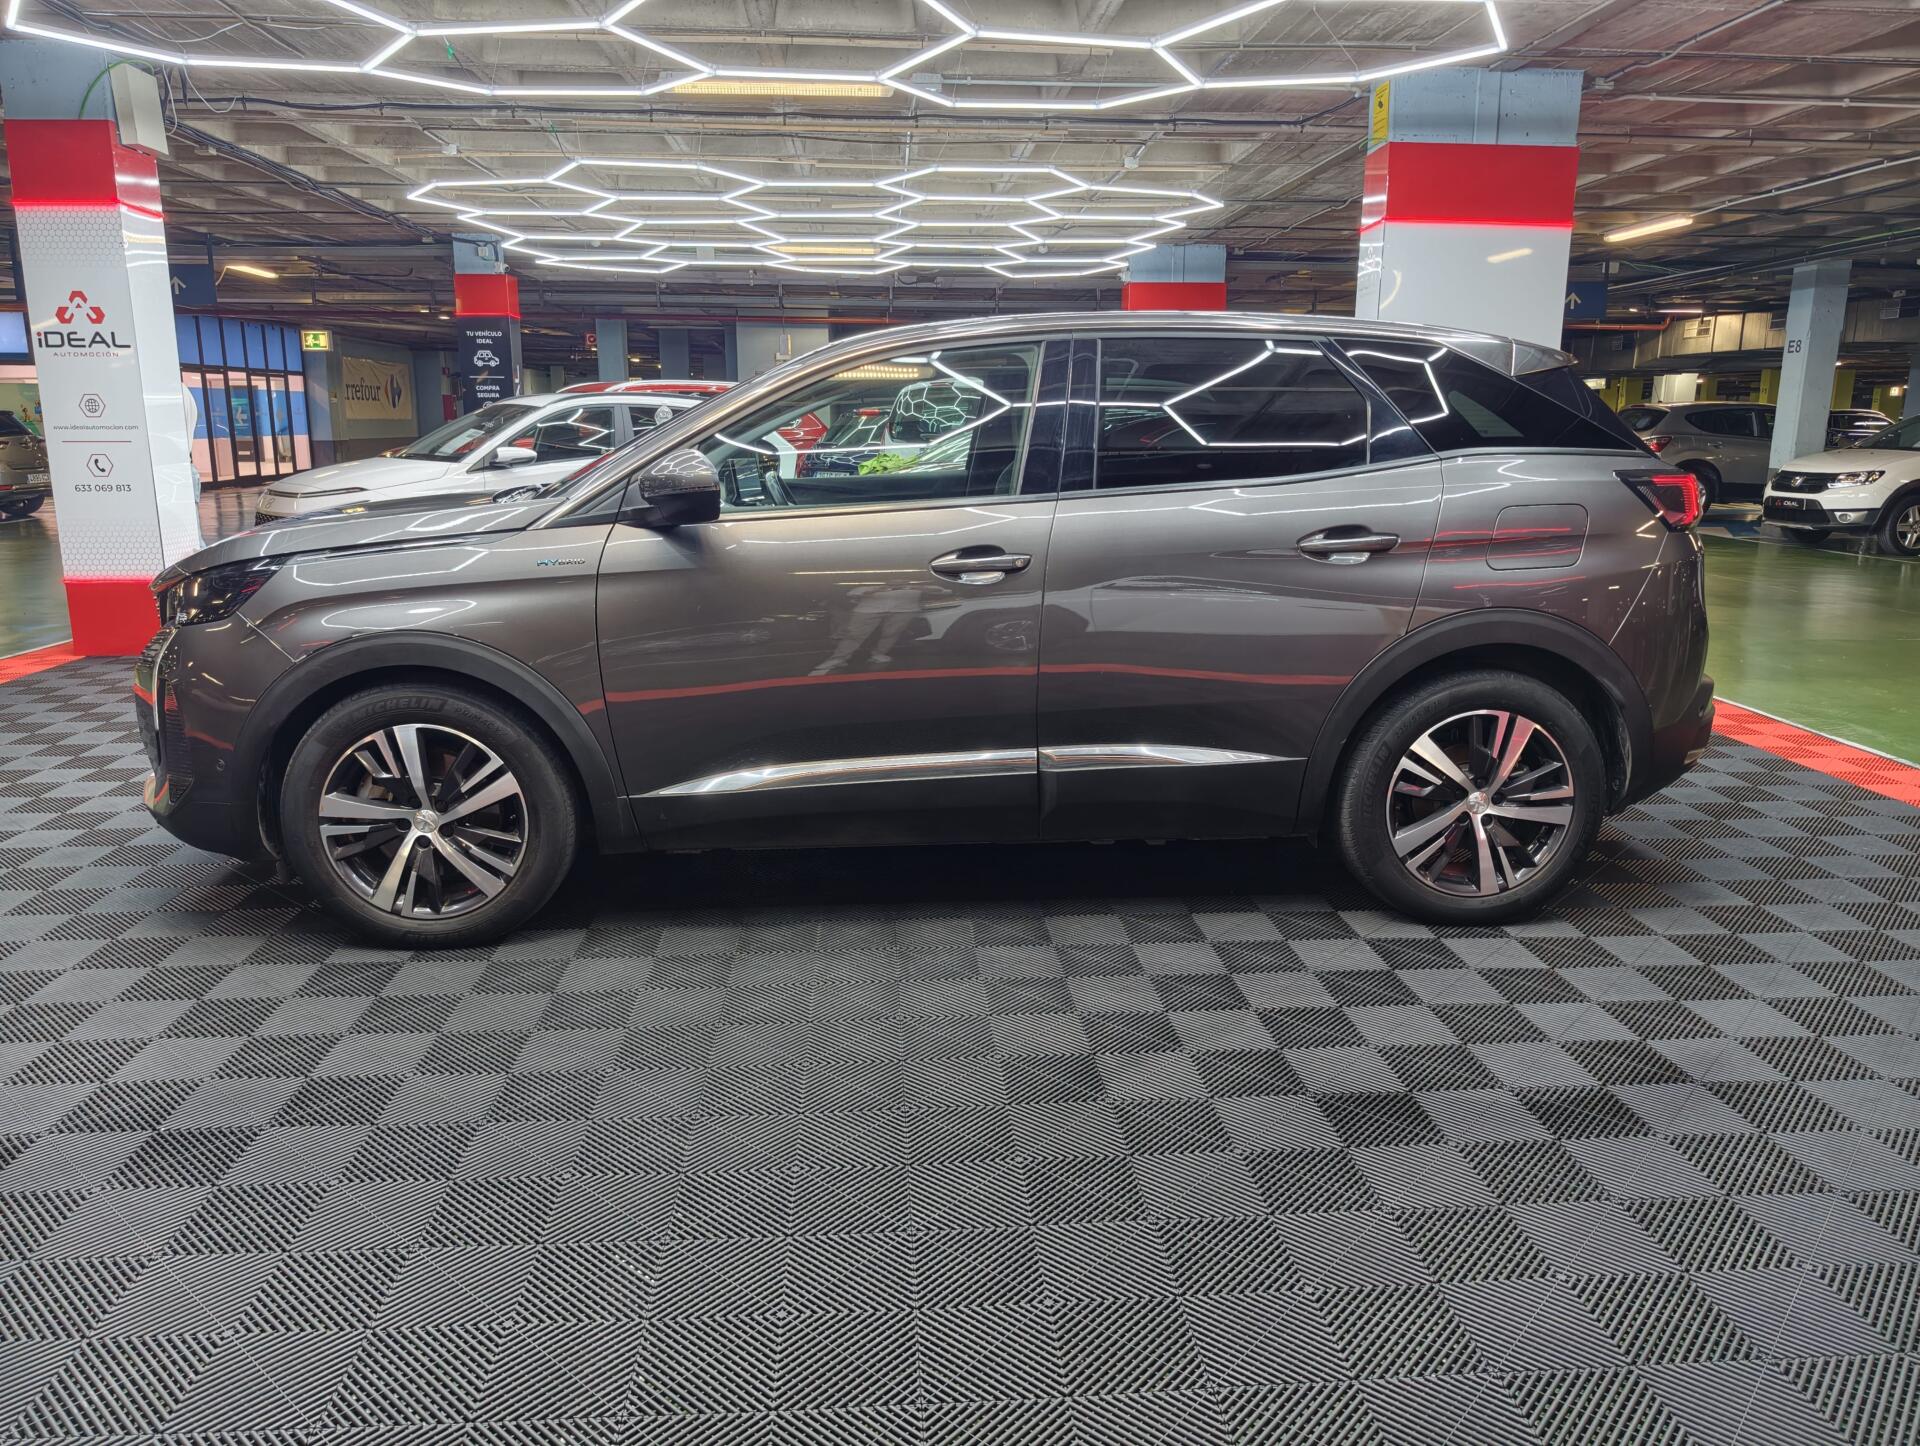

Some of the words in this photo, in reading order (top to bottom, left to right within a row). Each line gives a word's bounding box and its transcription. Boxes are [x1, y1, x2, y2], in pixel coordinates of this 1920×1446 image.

[475, 329, 502, 337] VEHÍCULO
[1787, 339, 1802, 354] E8
[345, 376, 381, 402] rrefour
[74, 484, 92, 492] 633
[94, 484, 113, 492] 069
[116, 484, 132, 492] 813
[536, 558, 586, 567] HYBRID
[353, 697, 445, 718] MICHELIN
